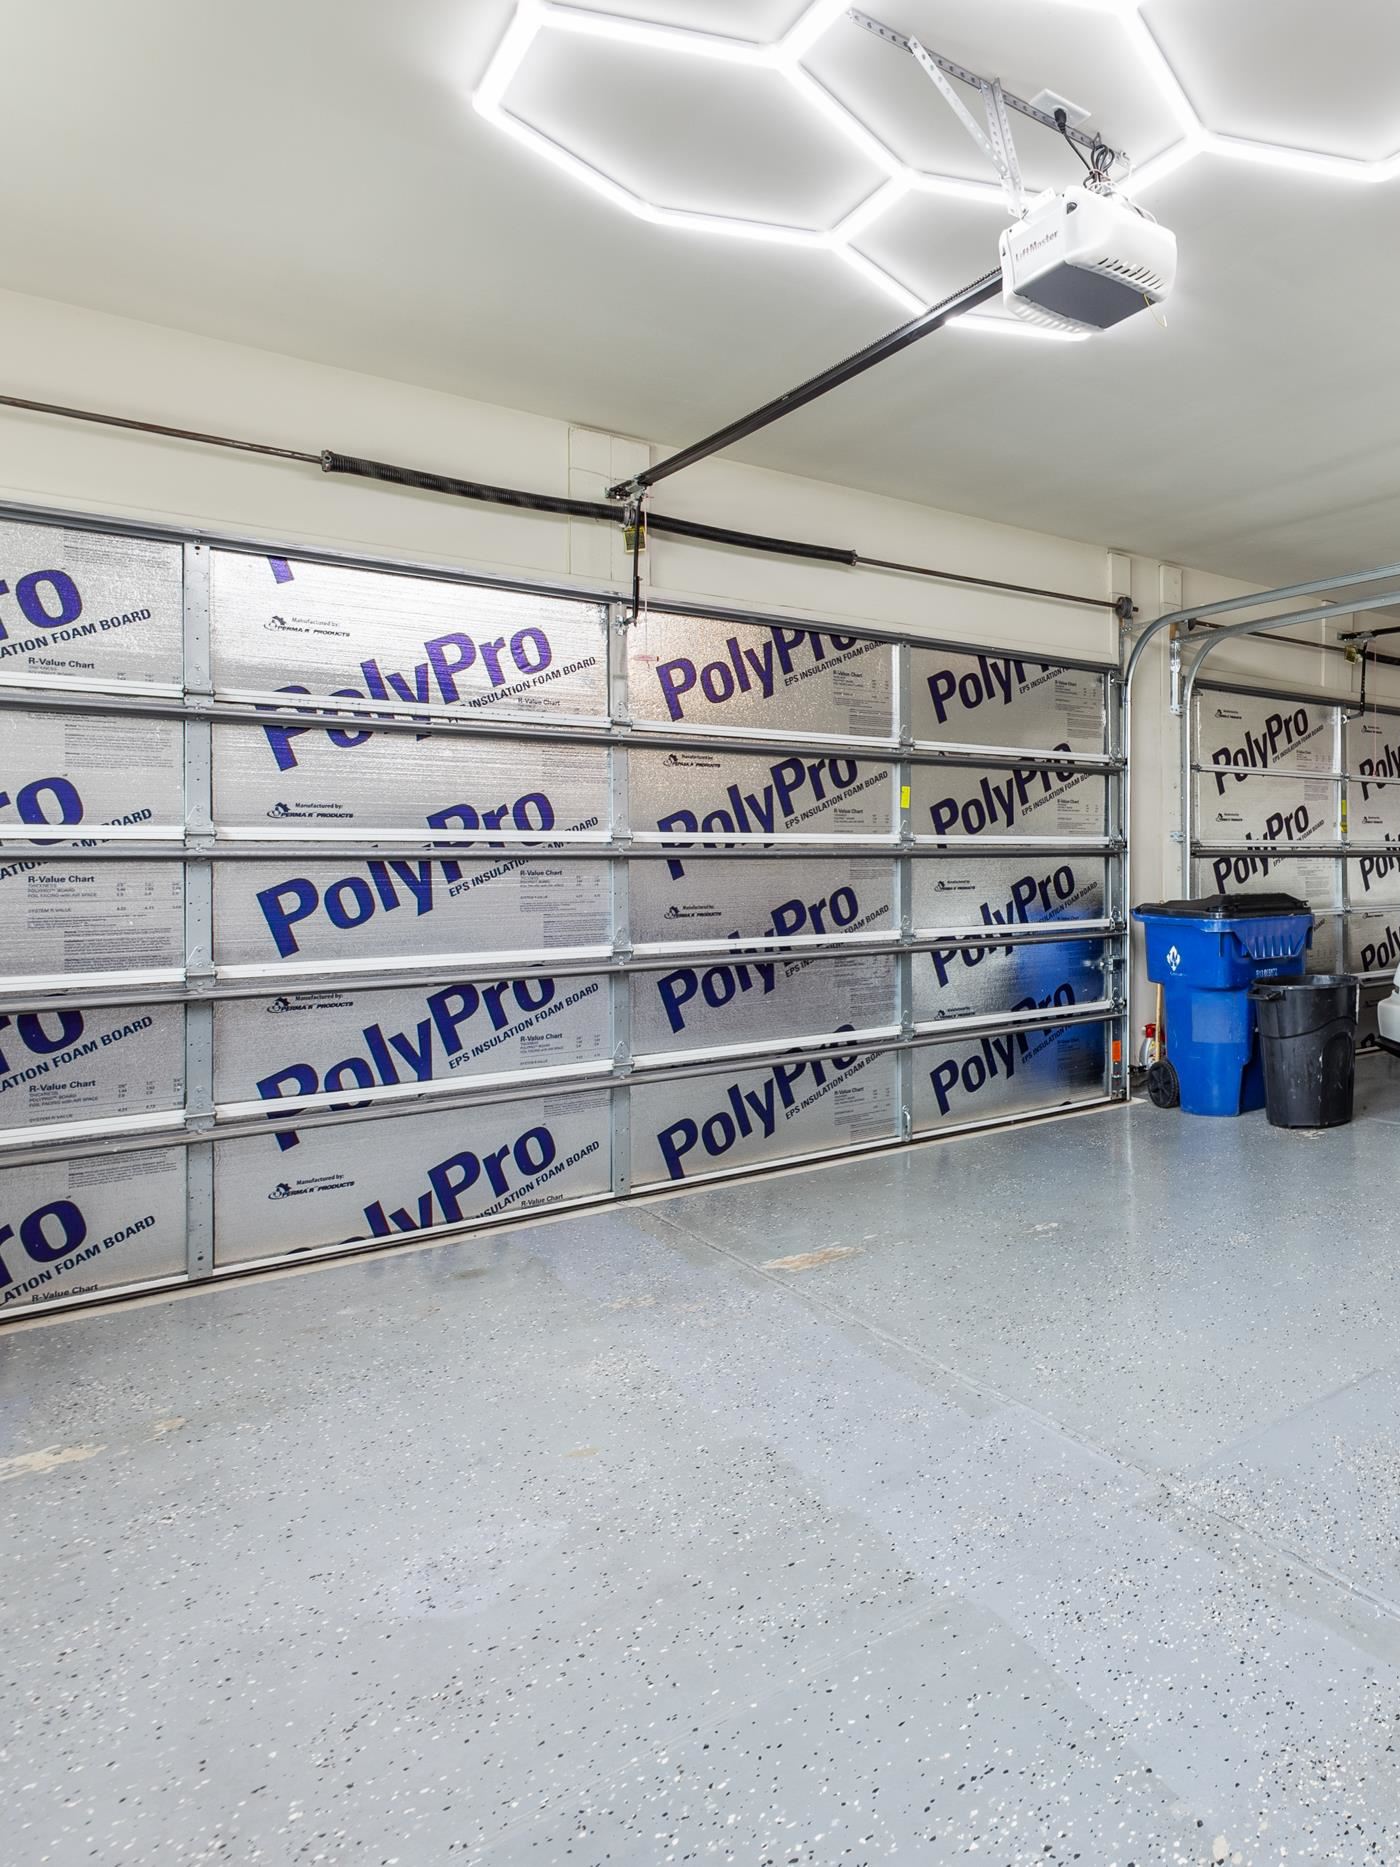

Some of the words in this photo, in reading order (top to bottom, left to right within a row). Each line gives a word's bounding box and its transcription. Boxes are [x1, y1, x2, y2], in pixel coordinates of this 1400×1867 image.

[0, 635, 48, 660] ATION
[51, 623, 97, 644] FOAM
[99, 608, 152, 632] BOARD
[313, 628, 351, 637] PRODUCTS
[28, 657, 66, 668] R-Value
[69, 660, 95, 669] Chart
[468, 680, 531, 708] INSULATION
[533, 669, 561, 687] FOAM
[563, 656, 596, 676] BOARD
[784, 674, 799, 687] EPS
[800, 656, 843, 681] INSULATION
[843, 647, 864, 663] FOAM
[1019, 683, 1030, 695] EPS
[1030, 668, 1063, 690] INSULATION
[254, 627, 552, 772] PolyPro
[1212, 708, 1309, 796] PolyPro
[785, 817, 800, 829] EPS
[801, 794, 843, 825] INSULATION
[843, 784, 864, 800] FOAM
[865, 770, 889, 788] BOARD
[1021, 805, 1033, 817] EPS
[1033, 787, 1065, 810] INSULATION
[1064, 779, 1081, 793] FOAM
[101, 808, 152, 830] OARD
[566, 816, 599, 833] OARD
[657, 757, 858, 880] PolyPro
[1213, 805, 1309, 894] PolyPro
[28, 875, 66, 883] R-Value
[68, 875, 95, 883] Chart
[256, 792, 555, 959] PolyPro
[448, 881, 471, 898] EPS
[471, 858, 531, 888] INSULATIO
[1064, 893, 1081, 909] FOAM
[1080, 881, 1098, 900] BOARD
[866, 904, 890, 923] BOARD
[930, 866, 1075, 988] PolyPro
[657, 886, 858, 1033] PolyPro
[785, 965, 800, 978] EPS
[295, 993, 334, 1001] Manufactured
[316, 1001, 354, 1009] PRODUCTS
[52, 1040, 99, 1067] FOAM
[100, 1016, 153, 1046] BOARD
[448, 1054, 471, 1070] EPS
[471, 1018, 534, 1058] INSULATION
[535, 1001, 564, 1023] FOAM
[566, 982, 599, 1006] BOARD
[519, 1034, 545, 1042] R-Value
[545, 1033, 563, 1041] Chart
[256, 964, 555, 1152] PolyPro
[1021, 1052, 1033, 1065] EPS
[1033, 1028, 1065, 1057] INSULATION
[29, 1082, 67, 1092] R-Value
[69, 1080, 96, 1089] Chart
[657, 1024, 858, 1180] PolyPro
[785, 1106, 801, 1120] EPS
[801, 1077, 844, 1112] INSULATION
[844, 1060, 865, 1080] FOAM
[287, 1126, 556, 1254] lyPro
[296, 1175, 335, 1185] Manufactured
[317, 1181, 355, 1192] PRODUCTS
[471, 1182, 534, 1220] NSULATION
[536, 1164, 565, 1186] FOAM
[566, 1140, 600, 1167] BOARD
[546, 1194, 564, 1202] Chart
[0, 1269, 53, 1308] ATION
[54, 1244, 101, 1275] FOAM
[103, 1215, 156, 1249] BOARD
[31, 1290, 69, 1303] R-Value
[72, 1284, 99, 1294] Chart
